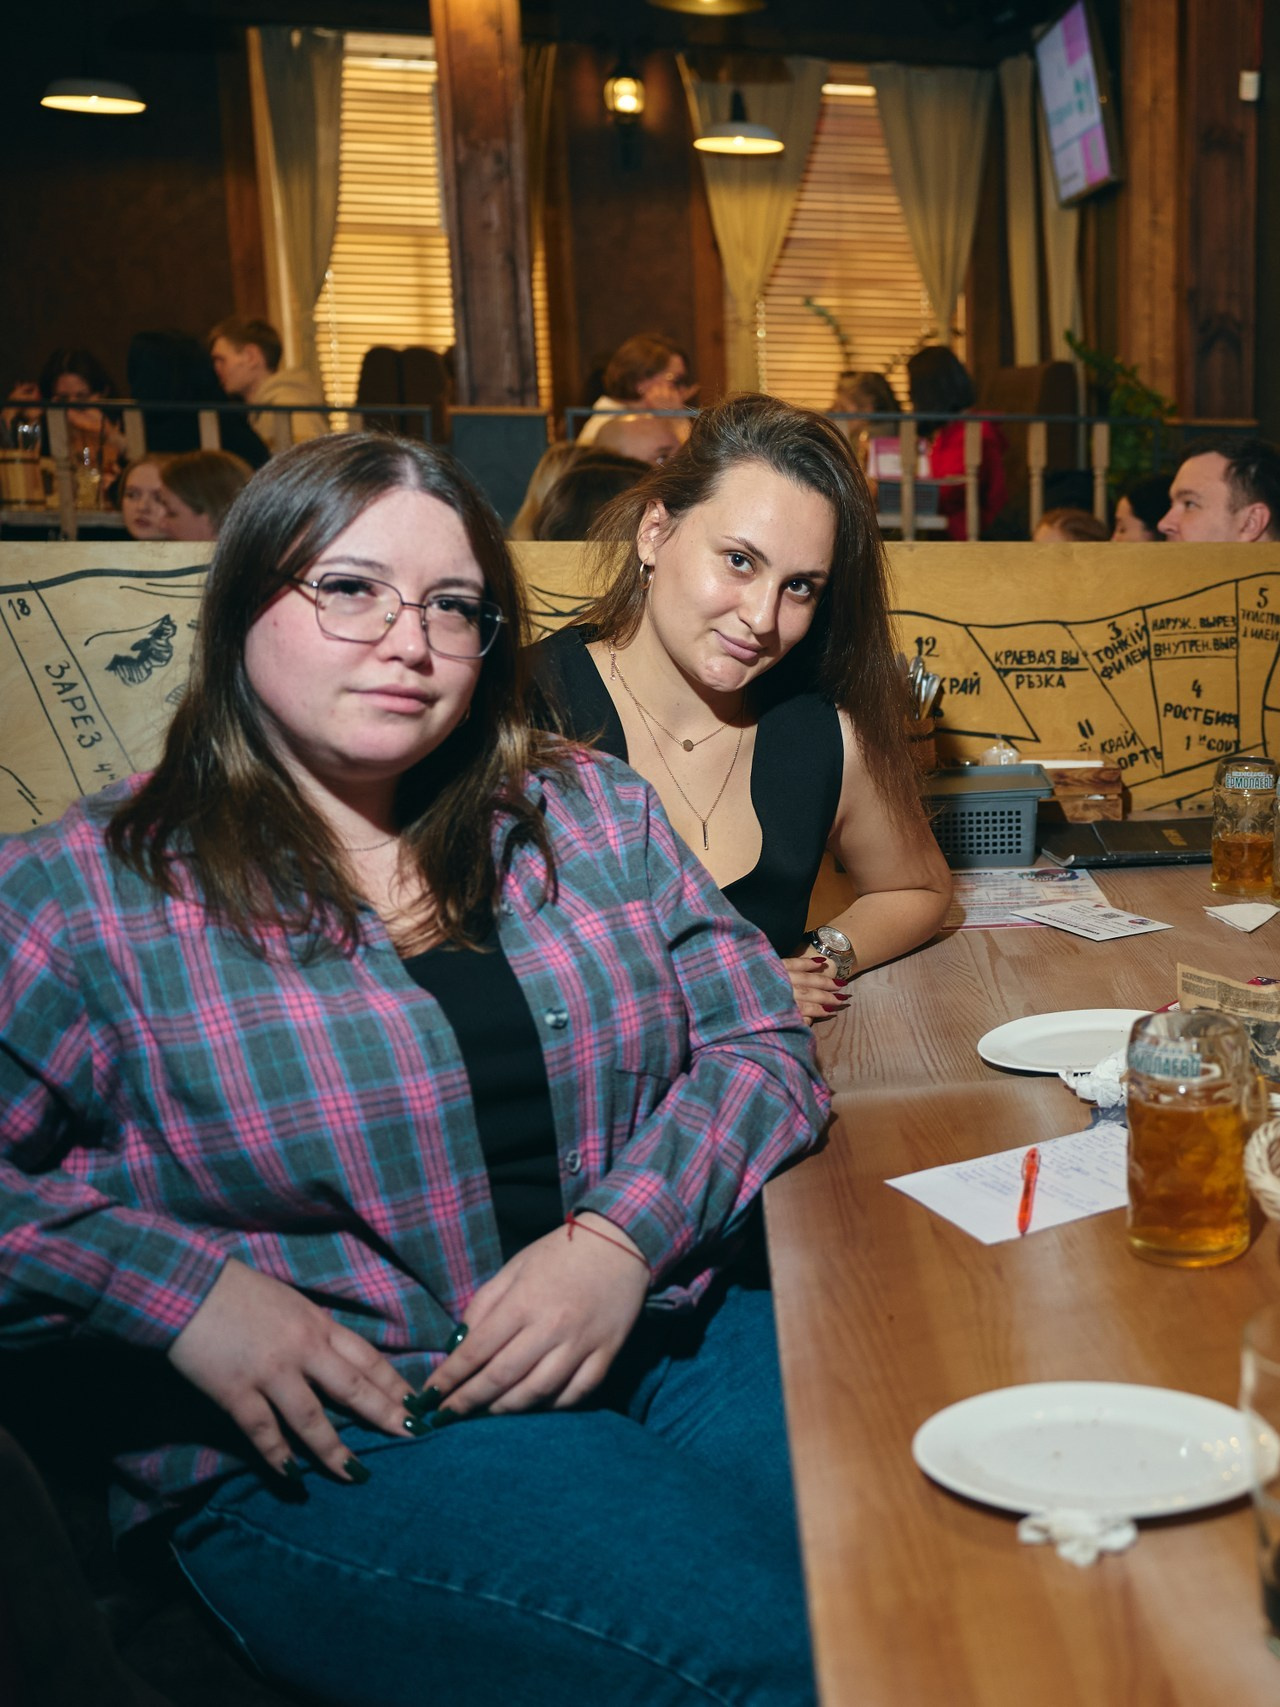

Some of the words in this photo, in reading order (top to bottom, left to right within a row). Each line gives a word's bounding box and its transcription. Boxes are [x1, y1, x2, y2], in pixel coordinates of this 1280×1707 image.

[1257, 587, 1269, 609] 5
[8, 598, 31, 621] 18
[1107, 621, 1122, 641] 3
[914, 636, 940, 658] 12
[994, 649, 1056, 666] КРАЕВАЯ
[1061, 650, 1079, 665] ВЫ
[1191, 679, 1202, 698] 4
[45, 660, 102, 749] ЗАРЕЗ
